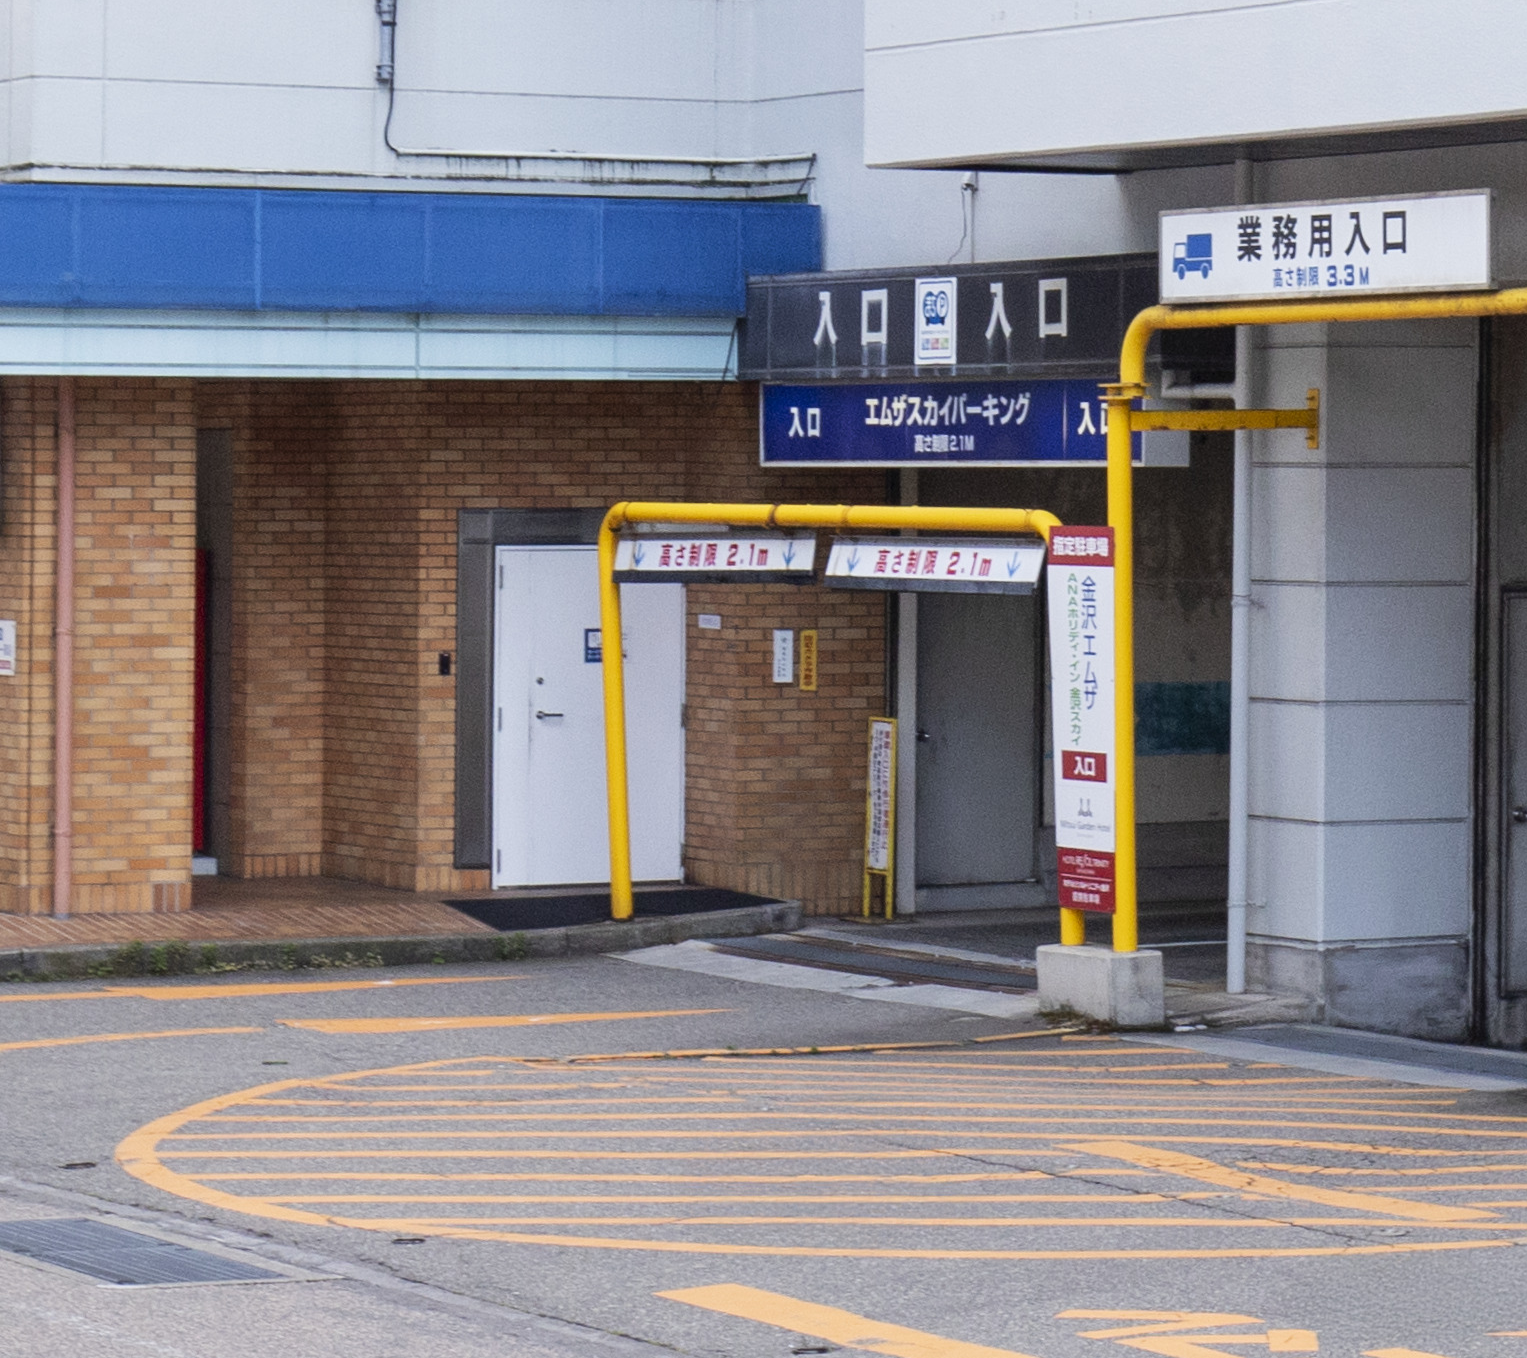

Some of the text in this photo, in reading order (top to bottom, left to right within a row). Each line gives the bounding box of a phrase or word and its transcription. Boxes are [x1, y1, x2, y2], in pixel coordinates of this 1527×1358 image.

[1237, 210, 1407, 262] 業務用入口
[1273, 266, 1319, 287] 高さ制限
[813, 289, 888, 346] 入口
[985, 278, 1067, 339] 入口
[788, 406, 821, 438] 入口
[865, 392, 1031, 427] エムザスカイパーキング
[658, 543, 718, 568] 高さ制限
[873, 548, 939, 576] 高さ制限
[1081, 575, 1099, 710] 金沢エムザ
[1074, 756, 1096, 776] 入口
